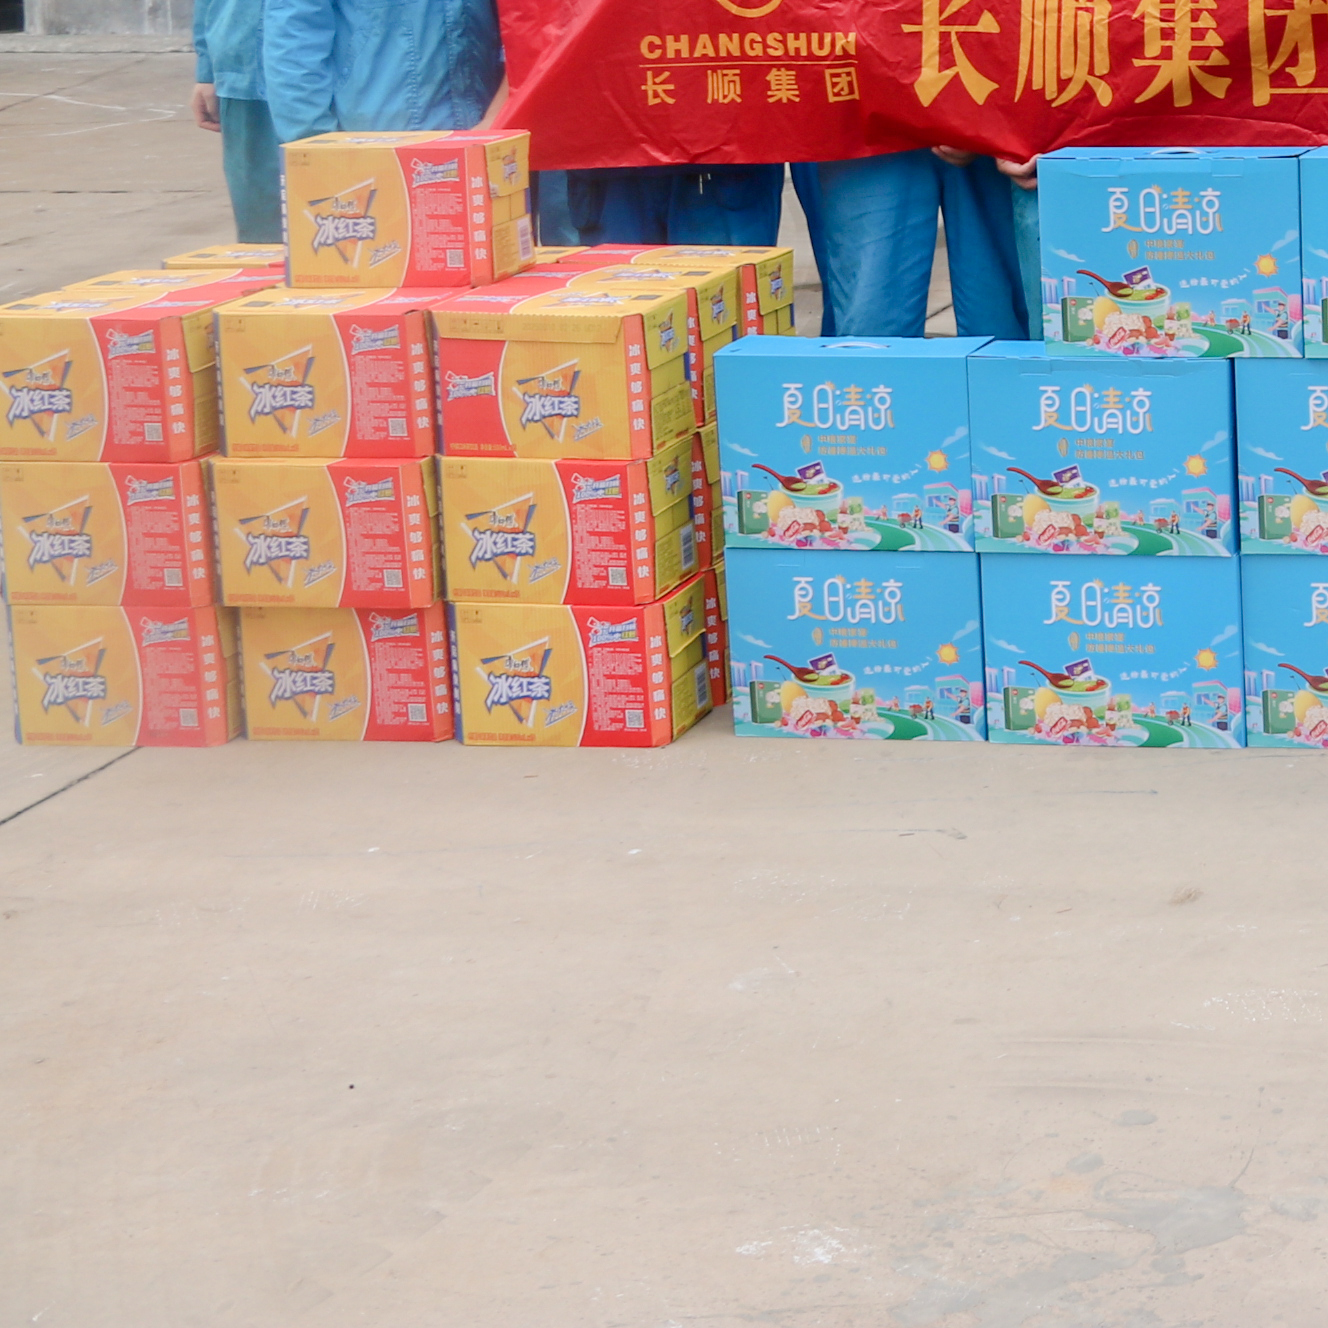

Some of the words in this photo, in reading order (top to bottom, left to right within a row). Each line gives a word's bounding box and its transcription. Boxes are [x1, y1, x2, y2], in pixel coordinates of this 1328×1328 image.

[639, 32, 858, 58] CHANGSHUN
[640, 68, 860, 106] 长顺集团
[1099, 184, 1223, 236] 夏日清凉
[312, 213, 375, 254] 冰红茶
[7, 385, 71, 427] 冰红茶
[249, 381, 314, 424] 冰红茶
[521, 392, 579, 430] 冰红茶
[774, 380, 895, 431] 夏日清凉
[1031, 383, 1153, 435] 夏日清凉
[28, 530, 91, 572] 冰红茶
[244, 532, 309, 574] 冰红茶
[470, 528, 534, 570] 冰红茶
[785, 574, 905, 624] 夏日清凉
[1042, 578, 1163, 629] 夏日清凉
[42, 672, 106, 713] 冰红茶
[270, 667, 333, 708] 冰红茶
[486, 673, 550, 713] 冰红茶
